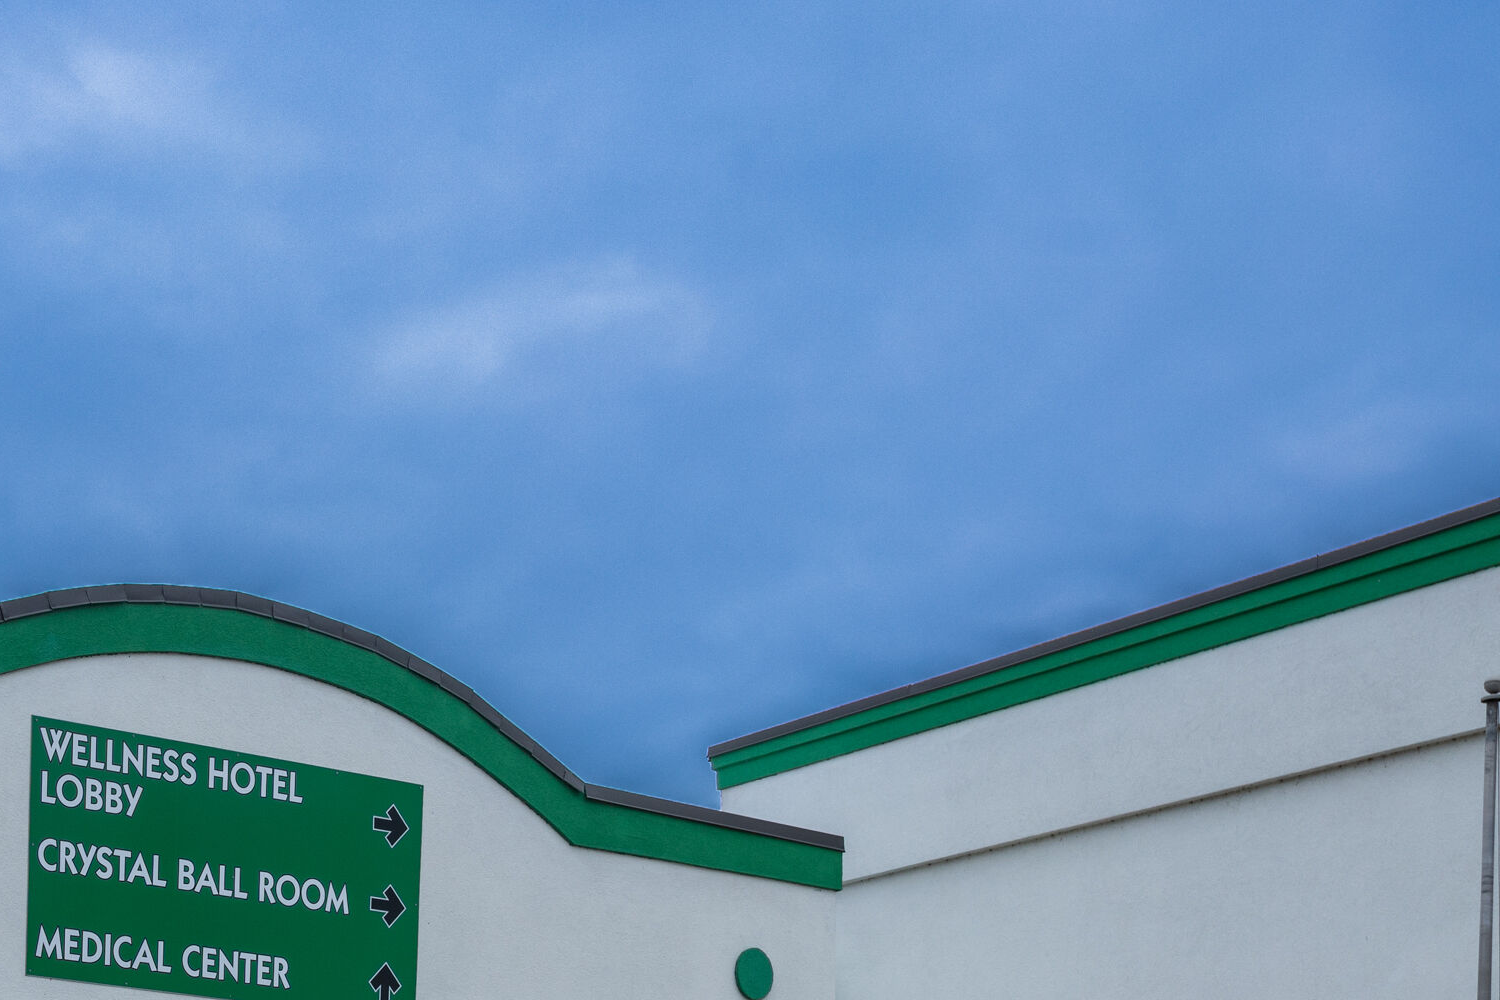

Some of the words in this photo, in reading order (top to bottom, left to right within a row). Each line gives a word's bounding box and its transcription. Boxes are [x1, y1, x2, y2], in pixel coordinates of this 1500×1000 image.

[40, 727, 197, 785] WELLNESS
[208, 757, 303, 804] HOTEL
[41, 770, 144, 817] LOBBY
[37, 838, 167, 888] CRYSTAL
[177, 858, 248, 900] BALL
[258, 871, 349, 915] ROOM
[35, 925, 172, 973] MEDICAL
[182, 944, 290, 989] CENTER
